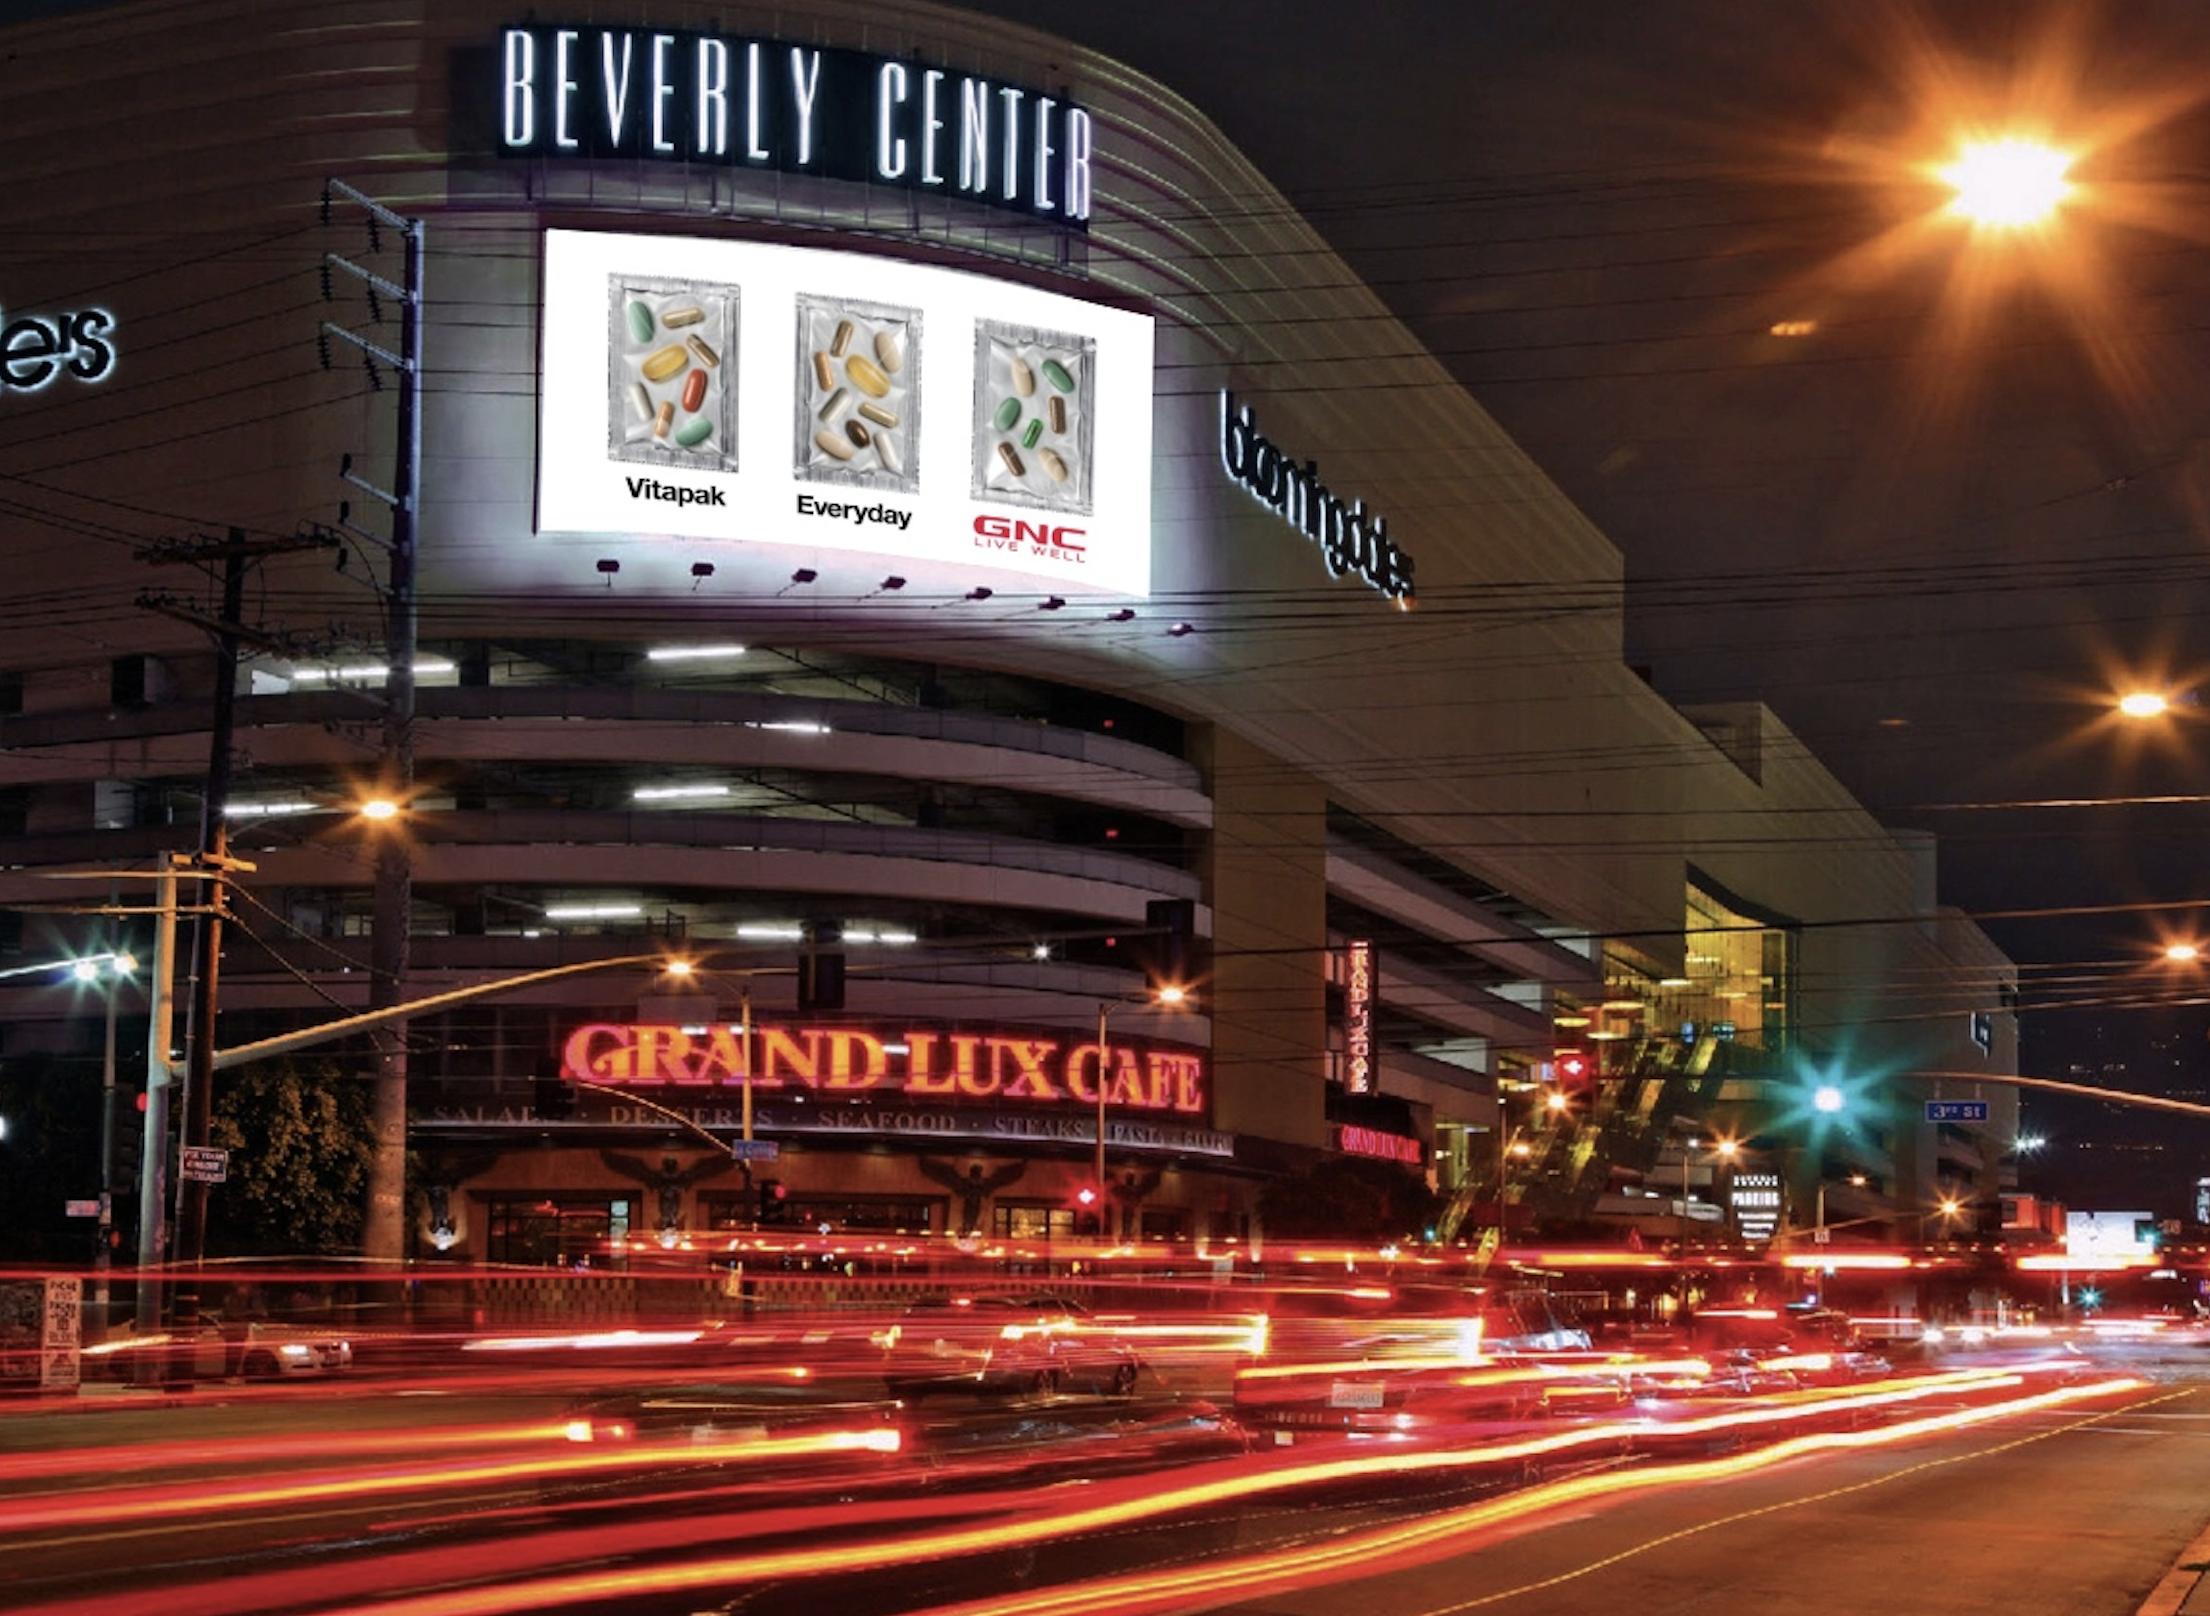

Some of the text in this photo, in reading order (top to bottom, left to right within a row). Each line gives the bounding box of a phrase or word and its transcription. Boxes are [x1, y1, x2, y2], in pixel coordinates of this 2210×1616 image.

[504, 29, 1092, 221] BEVERLY CENTER
[624, 476, 727, 507] Vitapak
[796, 494, 913, 530] Everyday
[972, 514, 1088, 552] GNC
[973, 538, 1087, 564] LIVE WELL
[564, 1023, 1205, 1113] GRAND LUX CAFE
[610, 1106, 774, 1128] DESSERS
[817, 1109, 956, 1131] SEAFOOD
[993, 1116, 1084, 1139] STEAKS
